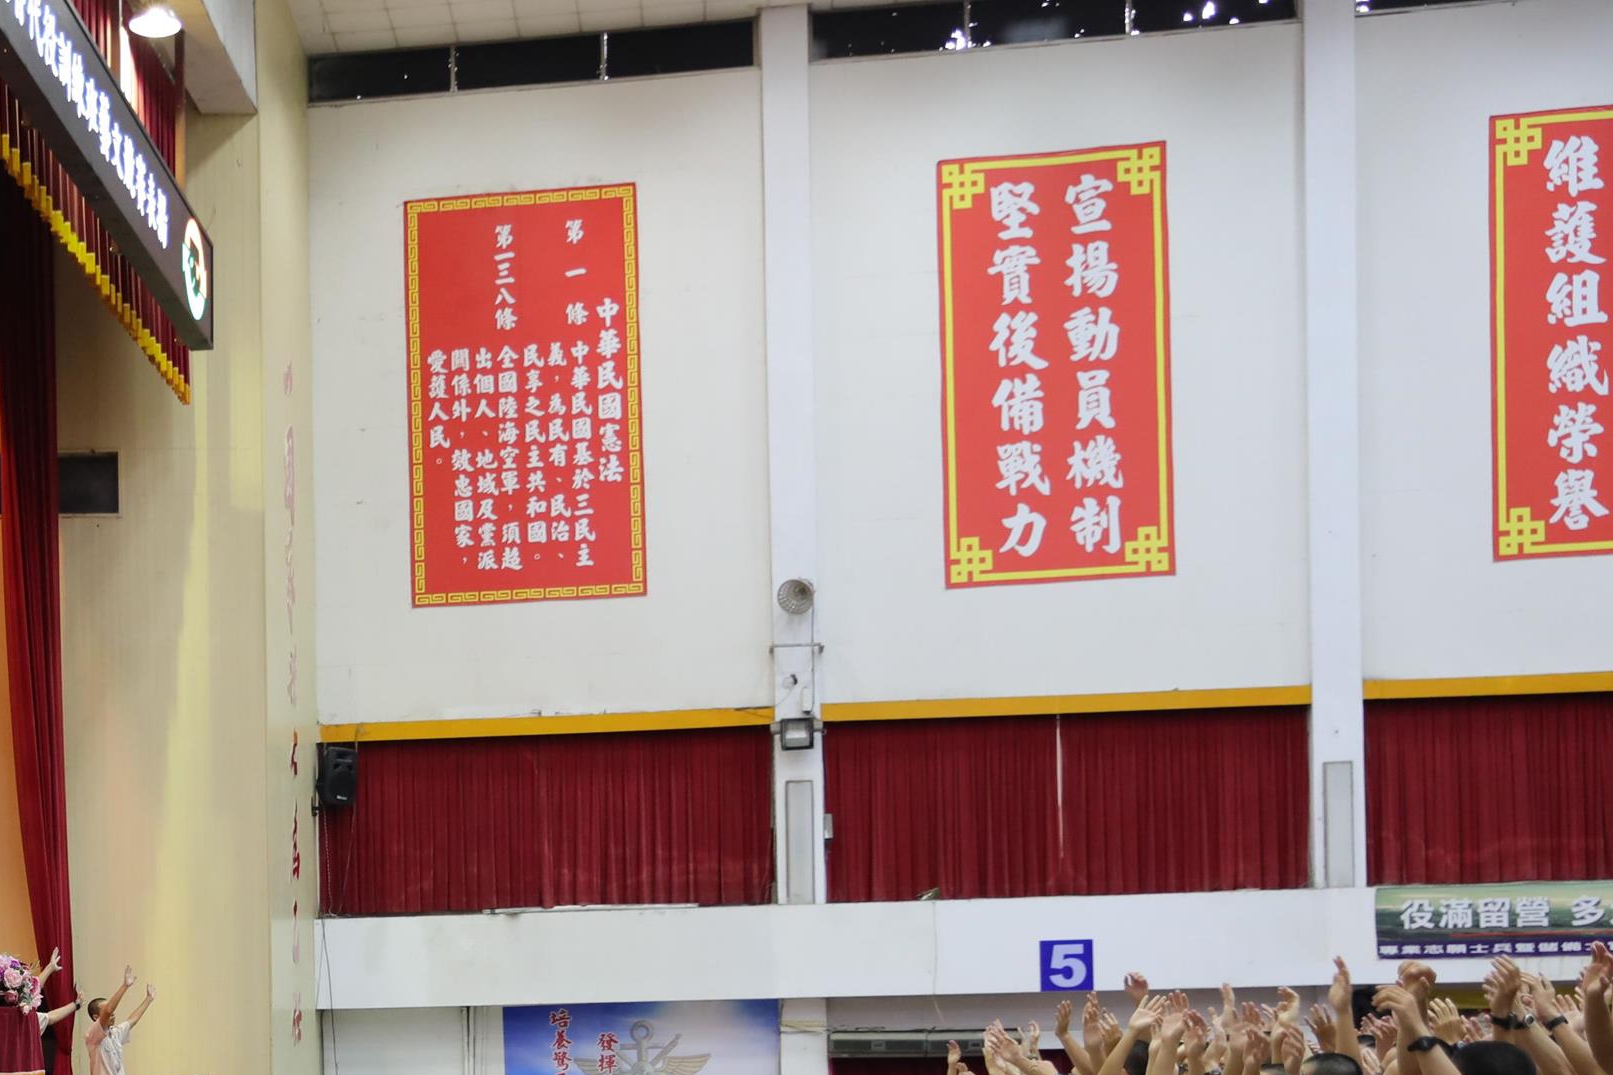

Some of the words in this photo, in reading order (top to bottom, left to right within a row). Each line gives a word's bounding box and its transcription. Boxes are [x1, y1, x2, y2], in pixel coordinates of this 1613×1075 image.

[493, 224, 518, 331] 第一三八條
[987, 180, 1051, 558] 堅實後備戰力
[1063, 173, 1125, 554] 宣揚動員機制
[1543, 135, 1609, 531] 維護組織榮譽
[596, 297, 624, 482] 中華民國憲法
[1049, 943, 1087, 988] 5
[1400, 897, 1549, 929] 役滿留營
[1571, 895, 1613, 927] 多
